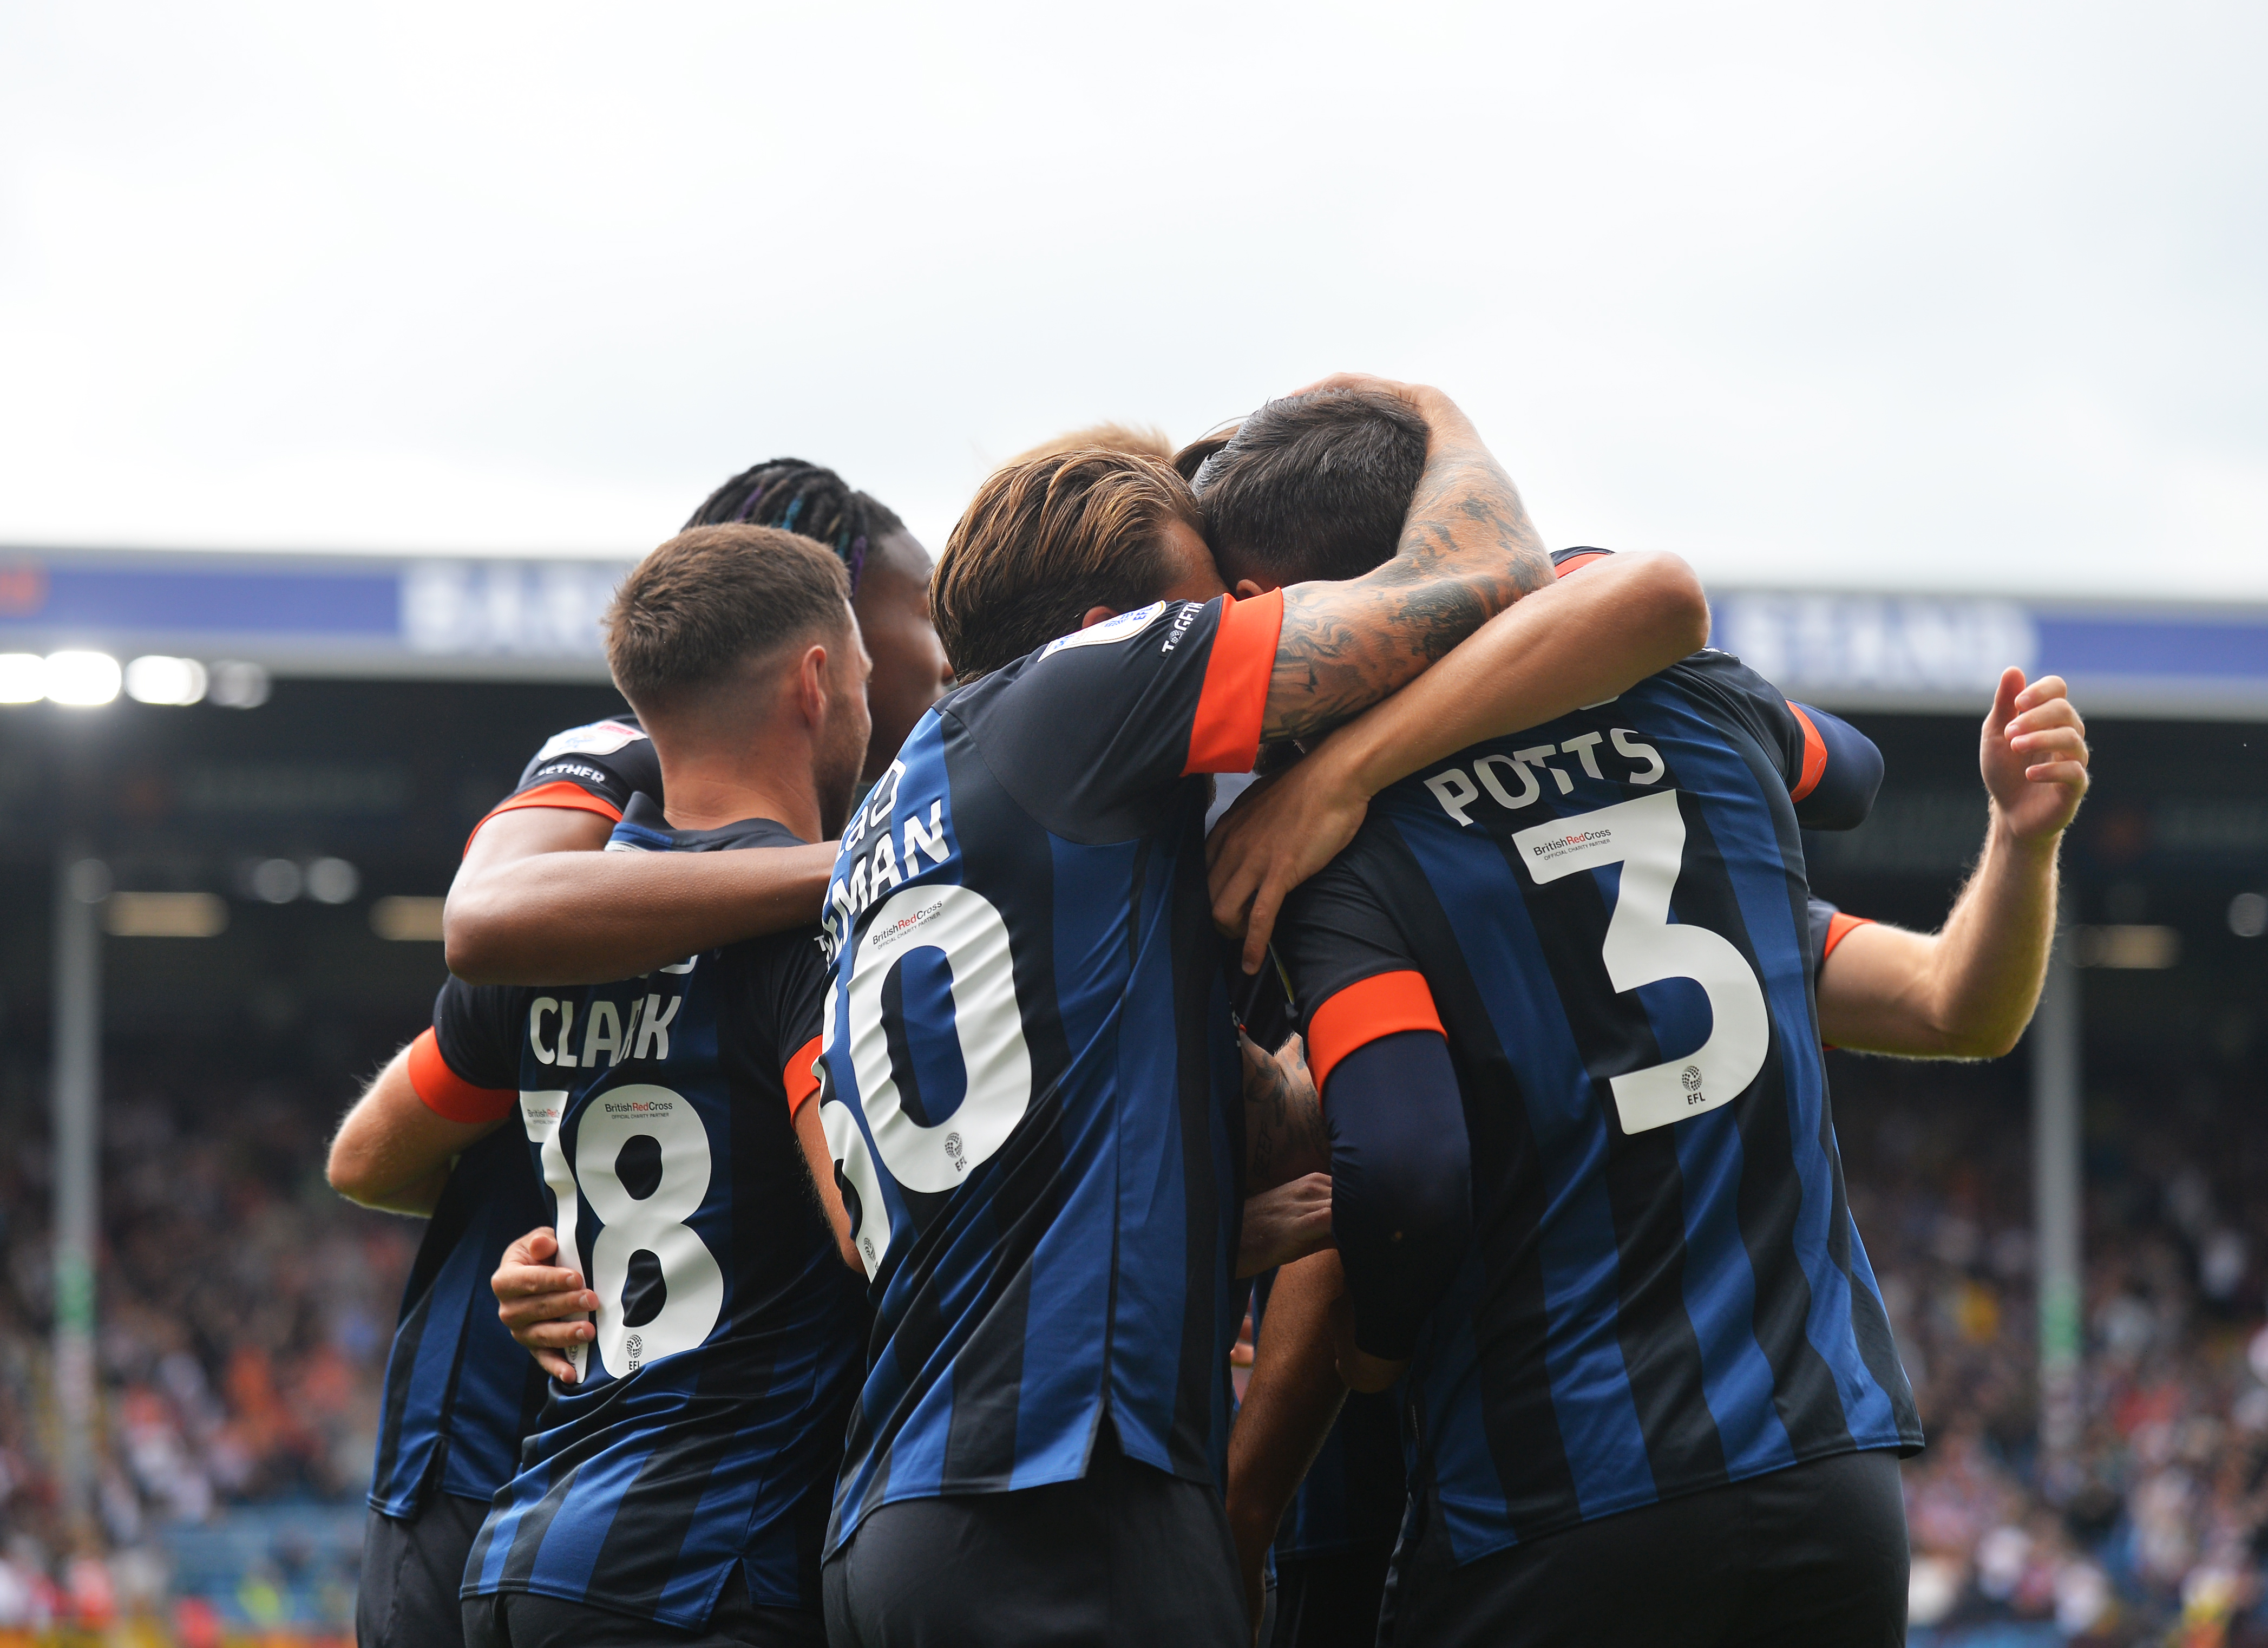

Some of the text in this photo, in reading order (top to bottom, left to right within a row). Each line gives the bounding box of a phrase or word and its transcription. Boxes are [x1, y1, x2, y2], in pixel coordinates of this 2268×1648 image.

[538, 763, 606, 783] ETHER
[1424, 728, 1665, 827] POTTS
[1533, 829, 1611, 855] BritishRedCross
[1544, 839, 1611, 860] OFFICIAL CHARITY PARTNER
[873, 900, 942, 945] BritishRedCross
[878, 912, 941, 950] OFFICIAL CHARITY PARTNER
[1512, 788, 1769, 1135] 3
[605, 1101, 673, 1112] BritishRedCross
[1687, 1092, 1706, 1105] EFL
